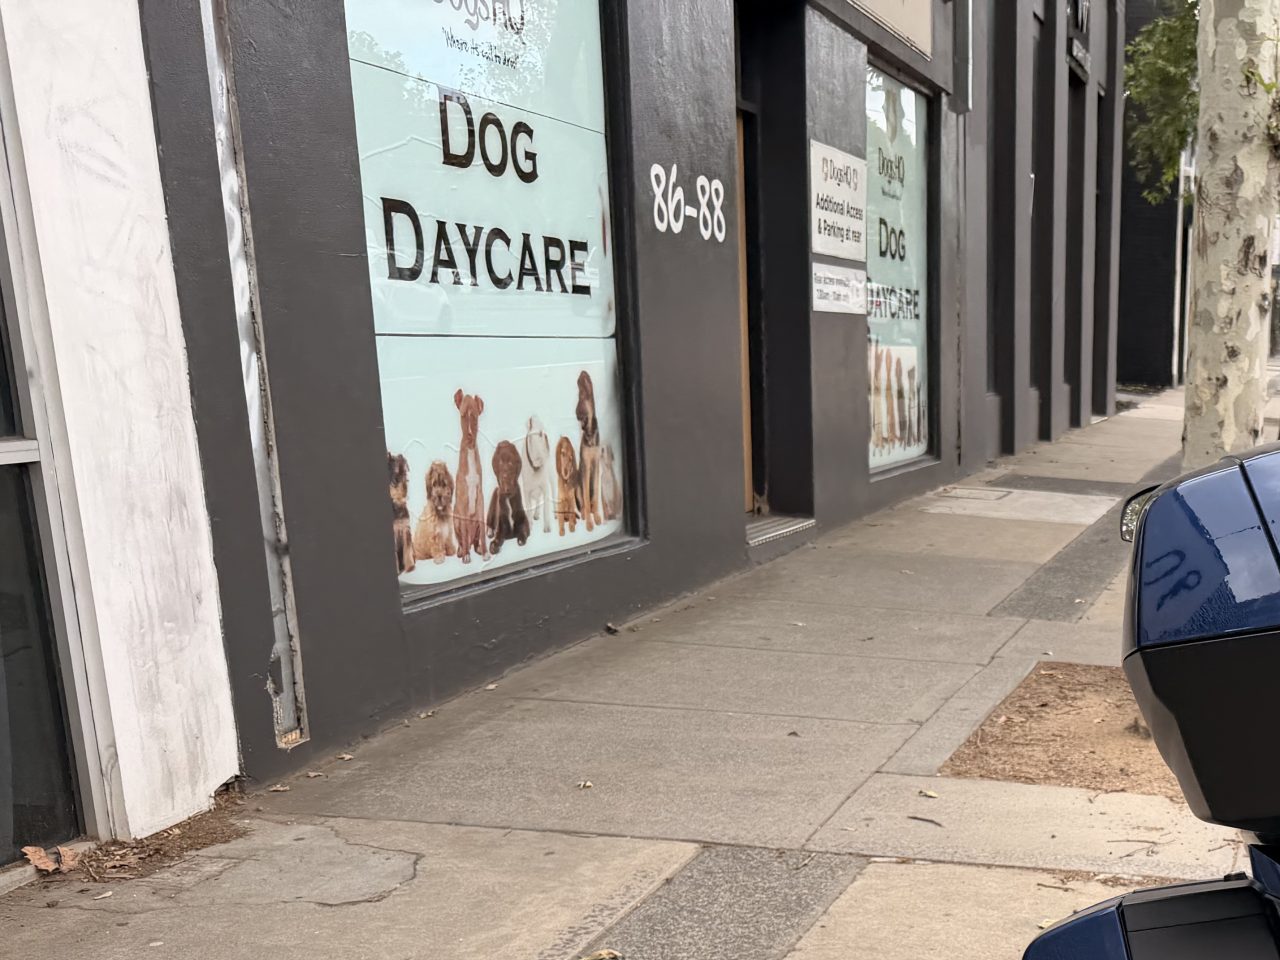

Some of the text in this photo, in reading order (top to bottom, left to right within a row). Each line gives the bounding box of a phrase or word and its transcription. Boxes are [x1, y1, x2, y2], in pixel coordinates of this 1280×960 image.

[437, 84, 539, 184] DOG
[650, 163, 727, 243] 86-88
[816, 192, 864, 221] Additional Access
[818, 218, 823, 235] &
[823, 219, 845, 243] Parking
[845, 226, 852, 242] at
[379, 196, 593, 298] DAYCARE
[879, 217, 907, 262] DOG
